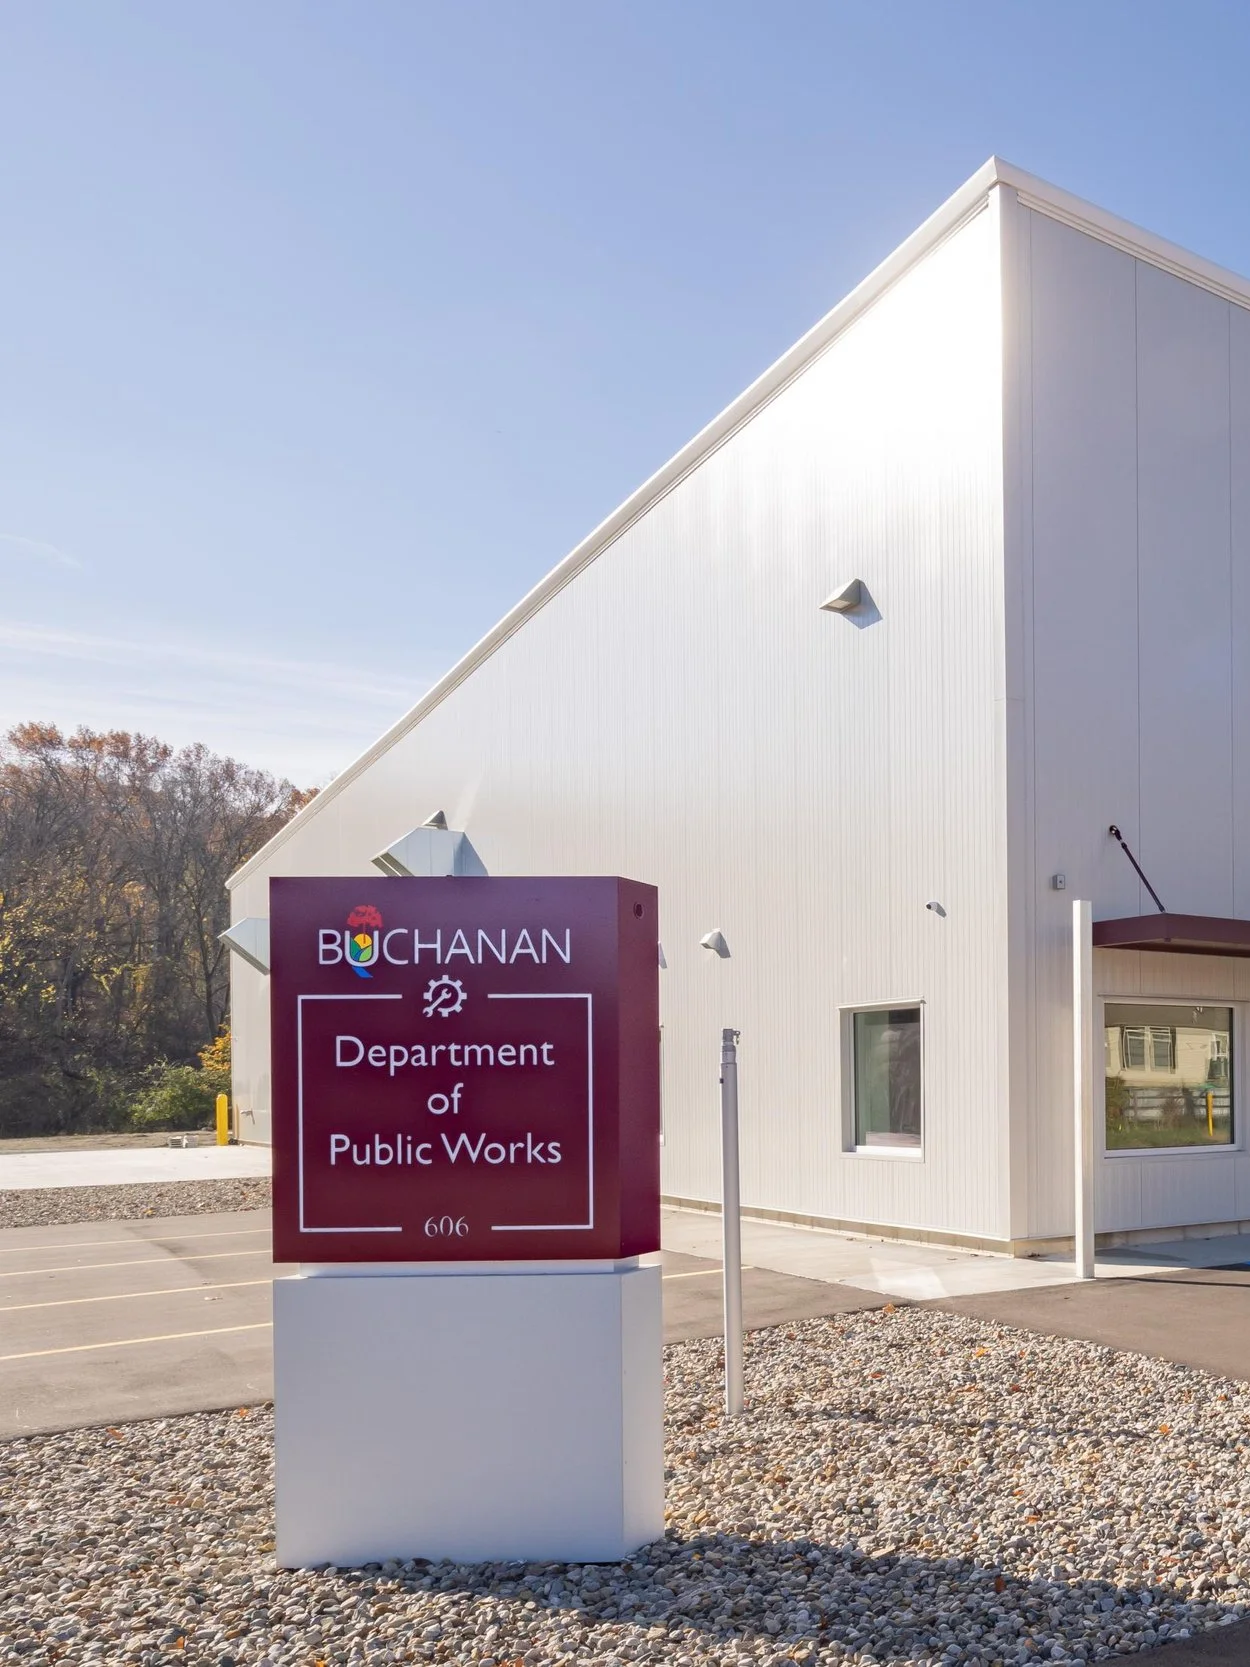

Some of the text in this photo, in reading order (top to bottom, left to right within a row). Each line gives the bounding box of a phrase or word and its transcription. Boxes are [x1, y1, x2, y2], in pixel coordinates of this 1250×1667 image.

[318, 928, 571, 966] BUCHANAN
[335, 1035, 555, 1076] Department
[427, 1082, 464, 1115] of
[330, 1132, 562, 1166] Public Works
[424, 1215, 469, 1238] 606
